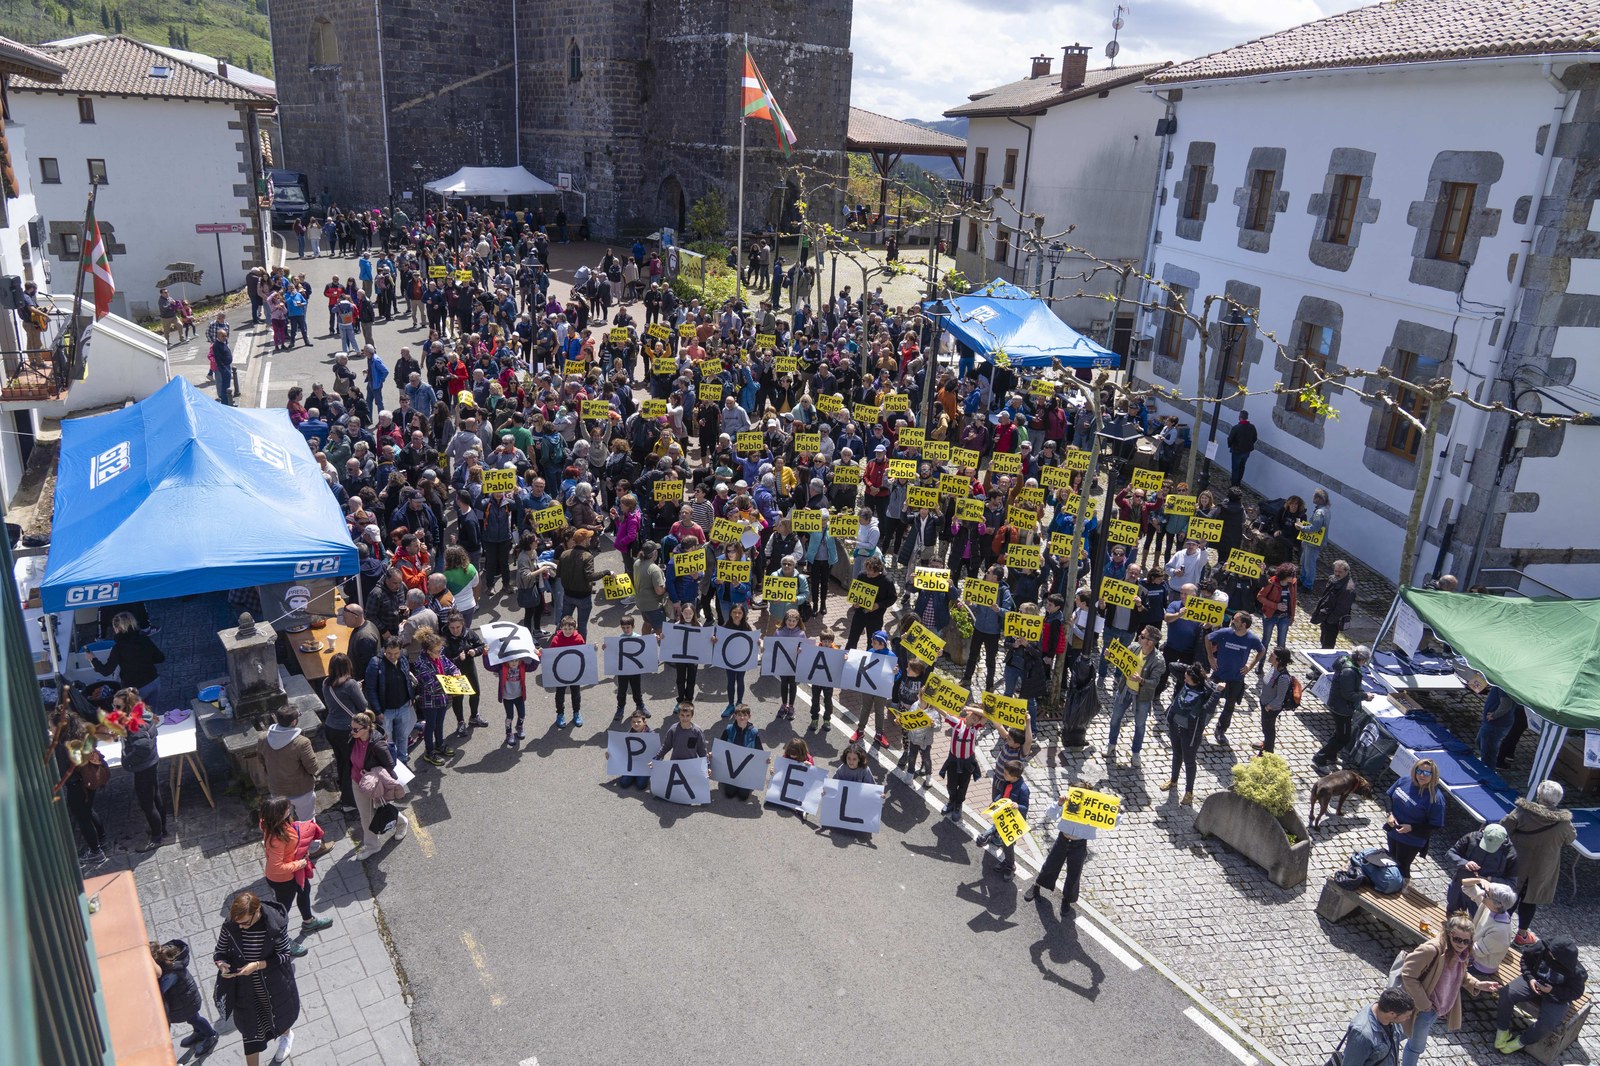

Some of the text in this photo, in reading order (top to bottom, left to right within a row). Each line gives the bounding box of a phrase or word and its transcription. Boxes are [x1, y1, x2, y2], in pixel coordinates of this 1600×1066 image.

[701, 360, 721, 369] #Free
[777, 357, 797, 365] #Free
[777, 364, 796, 372] Pablo
[701, 385, 722, 393] #Free
[701, 392, 720, 400] Pablo
[820, 396, 841, 405] #Free
[819, 402, 839, 412] Pablo
[856, 406, 878, 415] #Free
[885, 403, 907, 411] Pablo
[856, 414, 876, 423] Pablo
[900, 429, 925, 437] #Free
[739, 441, 762, 450] Pablo
[796, 442, 819, 451] Pablo
[900, 437, 923, 446] Pablo
[924, 442, 949, 451] #Free
[924, 450, 947, 460] Pablo
[953, 448, 979, 459] #Free
[994, 454, 1020, 464] #Free
[890, 461, 916, 469] #Free
[953, 457, 976, 467] Pablo
[890, 468, 914, 478] Pablo
[994, 463, 1018, 473] Pablo
[1044, 467, 1070, 478] #Free
[485, 471, 514, 480] #Free
[835, 475, 857, 484] Pablo
[942, 476, 969, 486] #Free
[1135, 470, 1162, 481] #Free
[486, 482, 514, 492] Pablo
[655, 482, 683, 491] #Free
[1042, 477, 1067, 488] Pablo
[1134, 480, 1159, 491] Pablo
[656, 491, 681, 499] Pablo
[909, 487, 937, 497] #Free
[942, 484, 966, 495] Pablo
[1021, 488, 1044, 497] #Free
[909, 497, 935, 507] Pablo
[535, 508, 563, 522] #Free
[793, 511, 822, 520] #Free
[1010, 507, 1036, 521] #Free
[1067, 504, 1091, 518] Pao
[539, 519, 564, 532] Pablo
[714, 519, 743, 534] #Free
[794, 522, 820, 531] Pablo
[830, 517, 859, 526] #Free
[1009, 517, 1033, 530] Pablo
[1110, 520, 1139, 534] #Free
[1190, 518, 1222, 531] #Free
[831, 527, 857, 536] Pablo
[1190, 529, 1219, 541] Pablo
[1108, 532, 1133, 545] Pablo
[1009, 546, 1040, 557] #Free
[675, 552, 705, 564] #Free
[1009, 557, 1038, 568] Pablo
[1230, 549, 1262, 566] #Free
[296, 556, 340, 574] GT2i
[677, 563, 705, 575] Pablo
[718, 561, 750, 572] #Free
[1229, 561, 1258, 576] Pablo
[916, 568, 949, 579] #Free
[765, 577, 797, 589] #Free
[917, 578, 946, 590] Pablo
[965, 579, 998, 595] #Free
[1103, 579, 1136, 596] #Free
[67, 582, 120, 603] GT2i
[607, 586, 633, 598] Pablo
[852, 581, 877, 597] #Free
[765, 589, 794, 601] Pablo
[849, 593, 872, 608] Pablo
[965, 591, 994, 606] Pablo
[1102, 590, 1131, 607] Pablo
[1188, 597, 1223, 614] #Free
[1008, 613, 1041, 628] #Free
[1186, 610, 1218, 624] Pablo
[1008, 625, 1038, 640] Pablo
[919, 634, 940, 653] #Free
[492, 623, 530, 659] Z
[553, 649, 585, 684] O
[618, 637, 646, 671] R
[672, 626, 701, 660] I
[722, 632, 753, 669] O
[771, 640, 802, 673] N
[808, 651, 833, 683] A
[855, 656, 880, 690] K
[915, 643, 936, 662] Pablo
[1110, 641, 1138, 669] #Free
[1108, 652, 1133, 677] Pablo
[938, 685, 966, 704] #Free
[937, 695, 962, 714] Pablo
[997, 701, 1027, 715] #Free
[998, 711, 1025, 726] Pablo
[905, 720, 929, 730] ablo
[625, 736, 864, 824] P A V E L
[1083, 797, 1118, 813] #Free
[1003, 806, 1023, 836] #Free
[1083, 810, 1115, 826] Pablo
[997, 815, 1015, 843] Pablo
